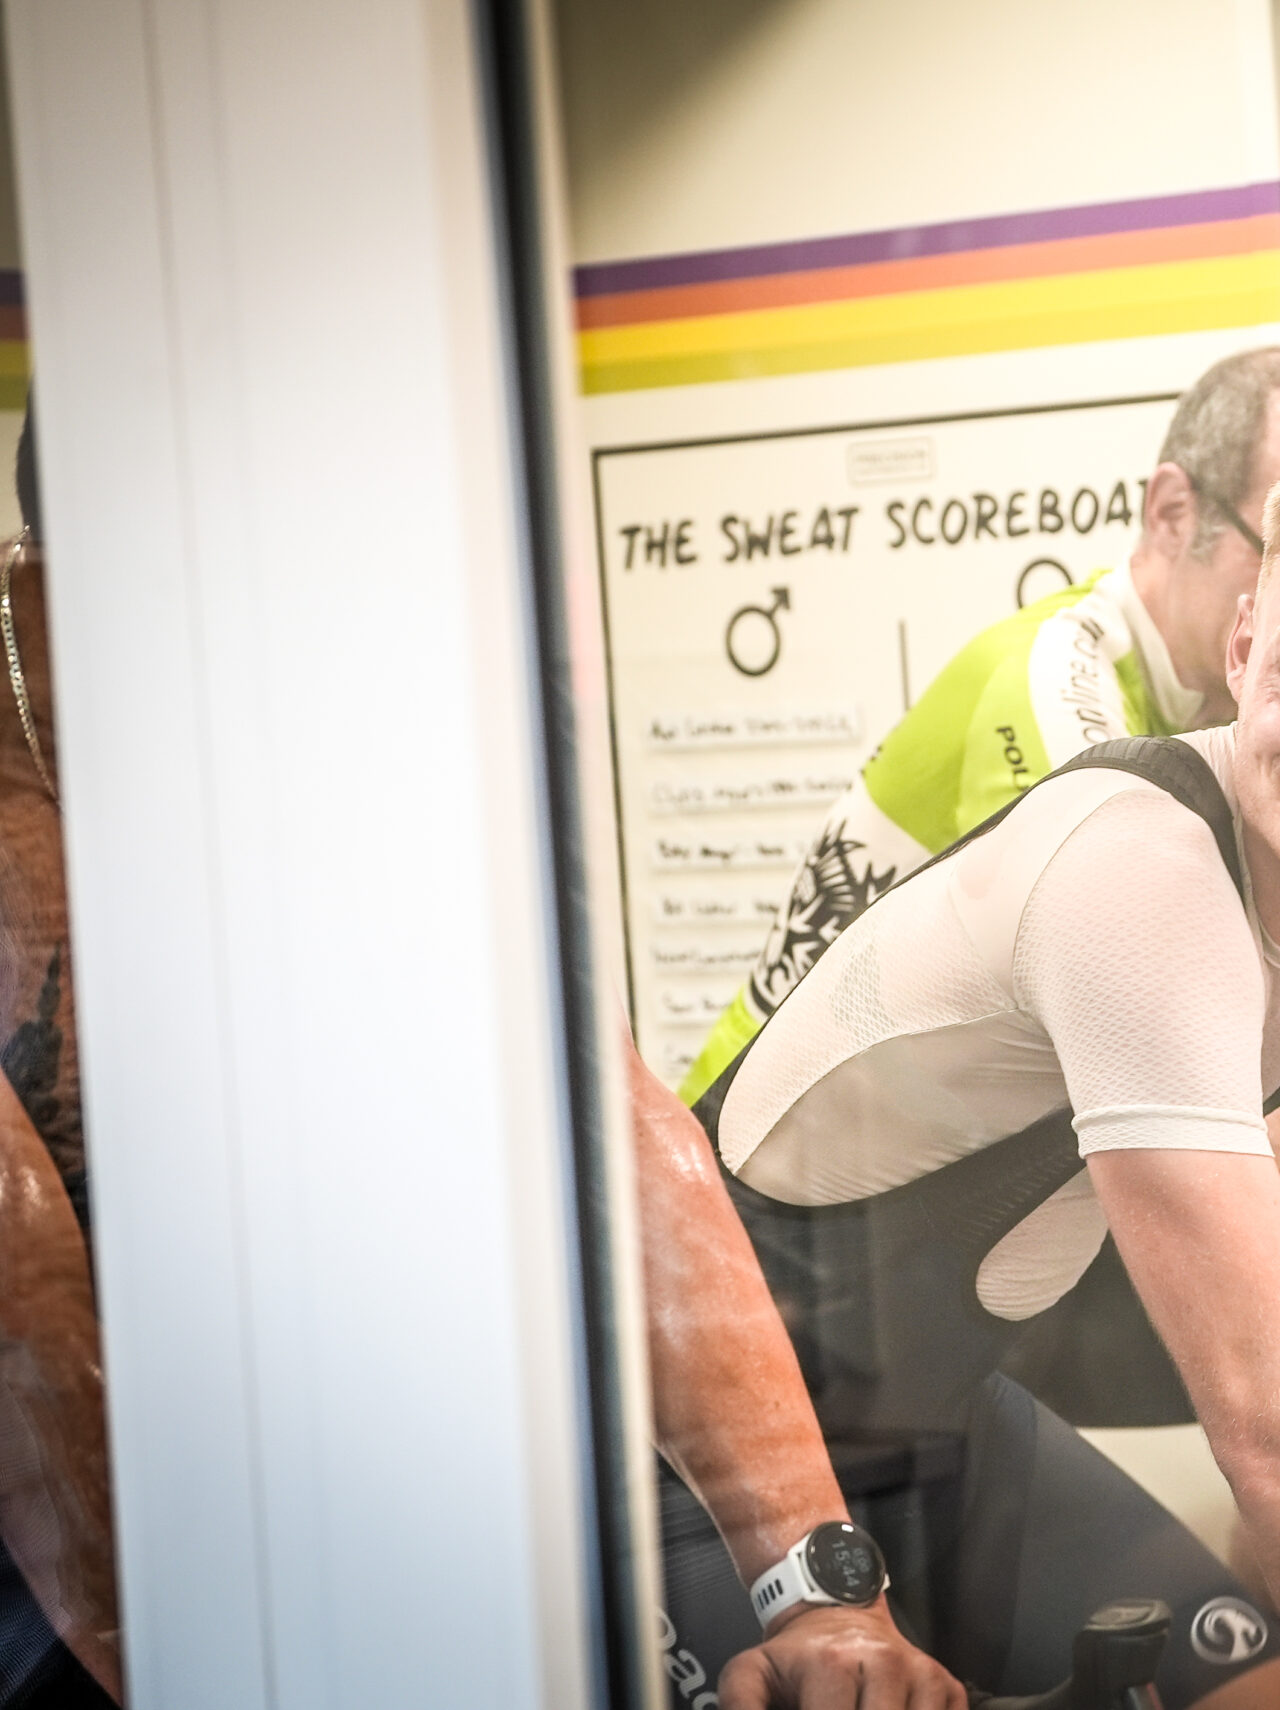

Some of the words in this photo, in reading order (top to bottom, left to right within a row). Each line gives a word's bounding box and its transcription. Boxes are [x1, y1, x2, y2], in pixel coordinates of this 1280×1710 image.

[619, 520, 698, 571] THE
[720, 502, 860, 564] SWEAT
[831, 1540, 860, 1587] 15:44
